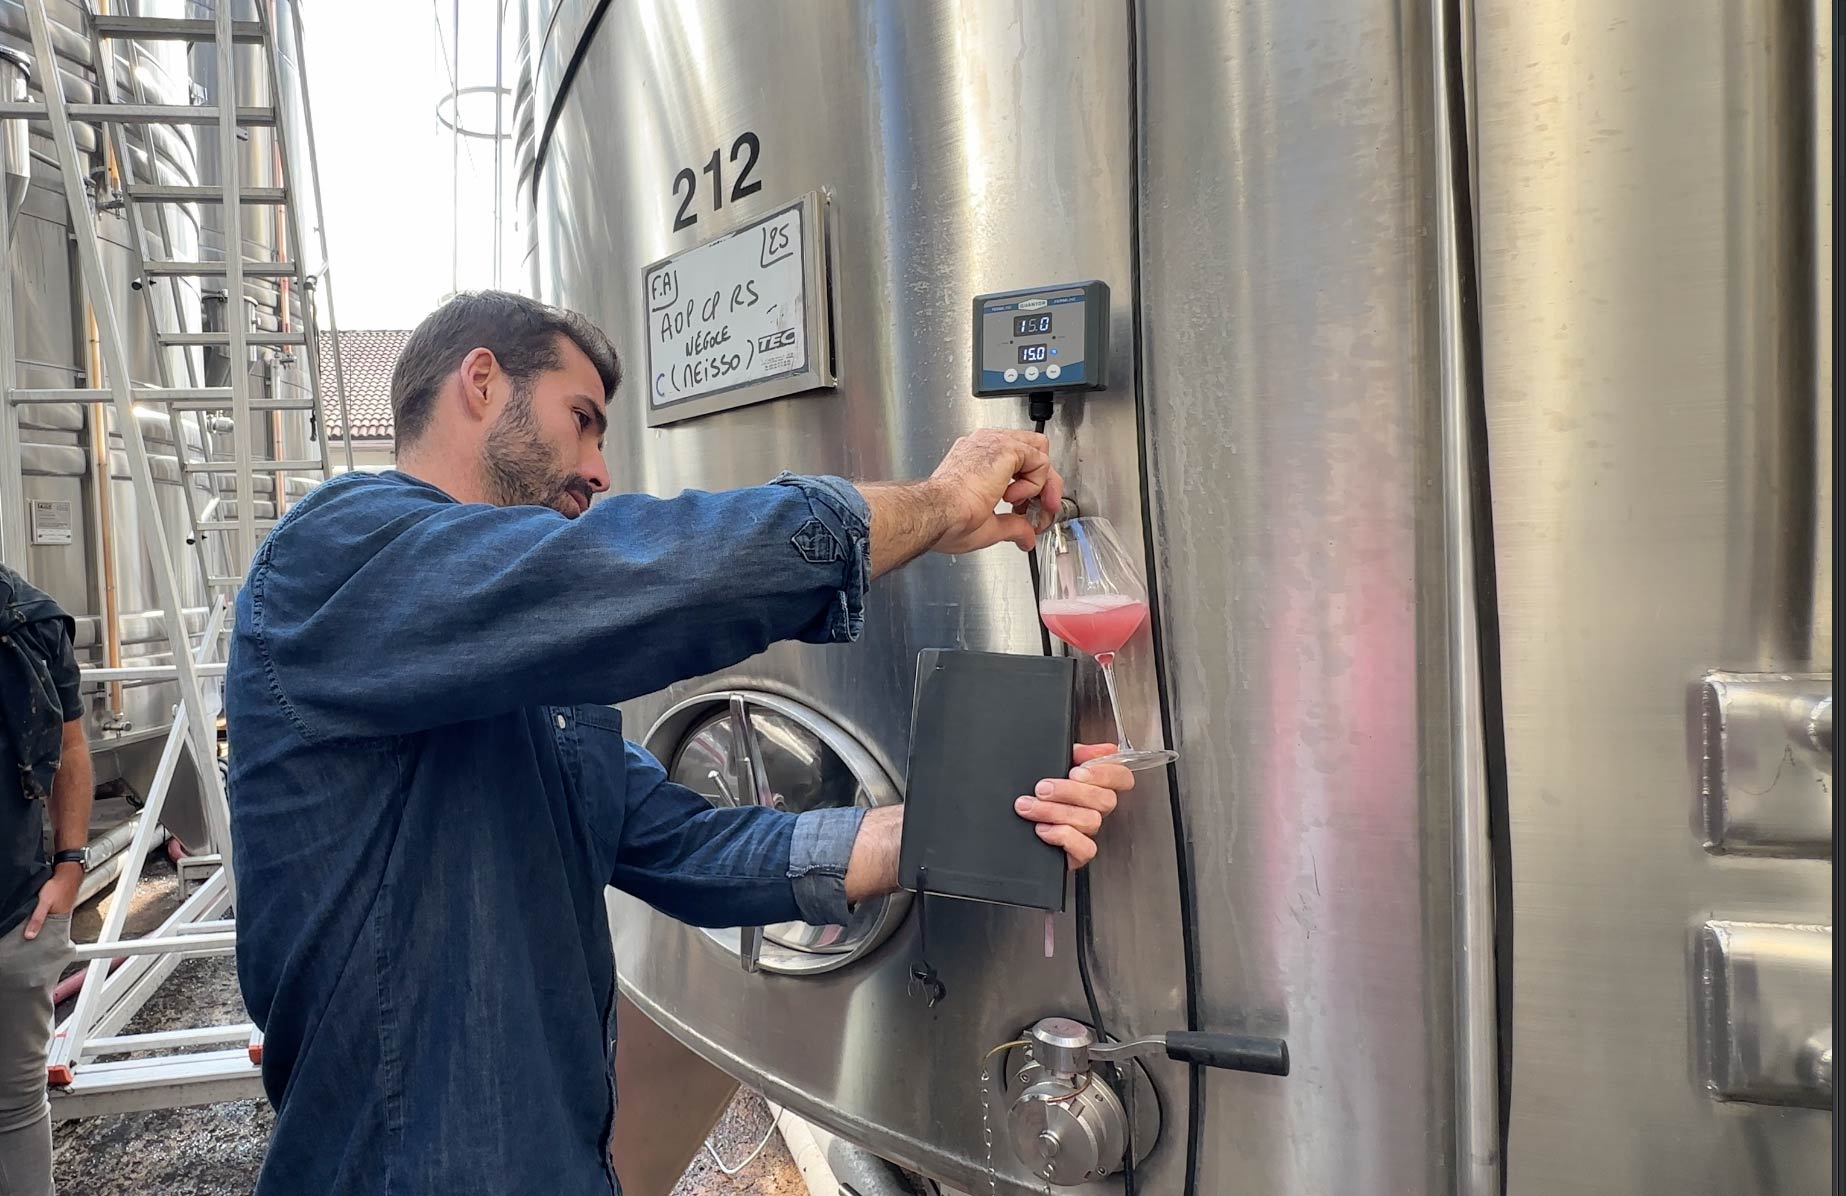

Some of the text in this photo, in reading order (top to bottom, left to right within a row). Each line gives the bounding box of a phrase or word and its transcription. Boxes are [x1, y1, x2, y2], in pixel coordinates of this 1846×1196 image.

[672, 131, 762, 233] 212
[661, 280, 759, 343] AOP CP RS
[758, 328, 795, 353] TEC
[1023, 346, 1046, 361] 15.0
